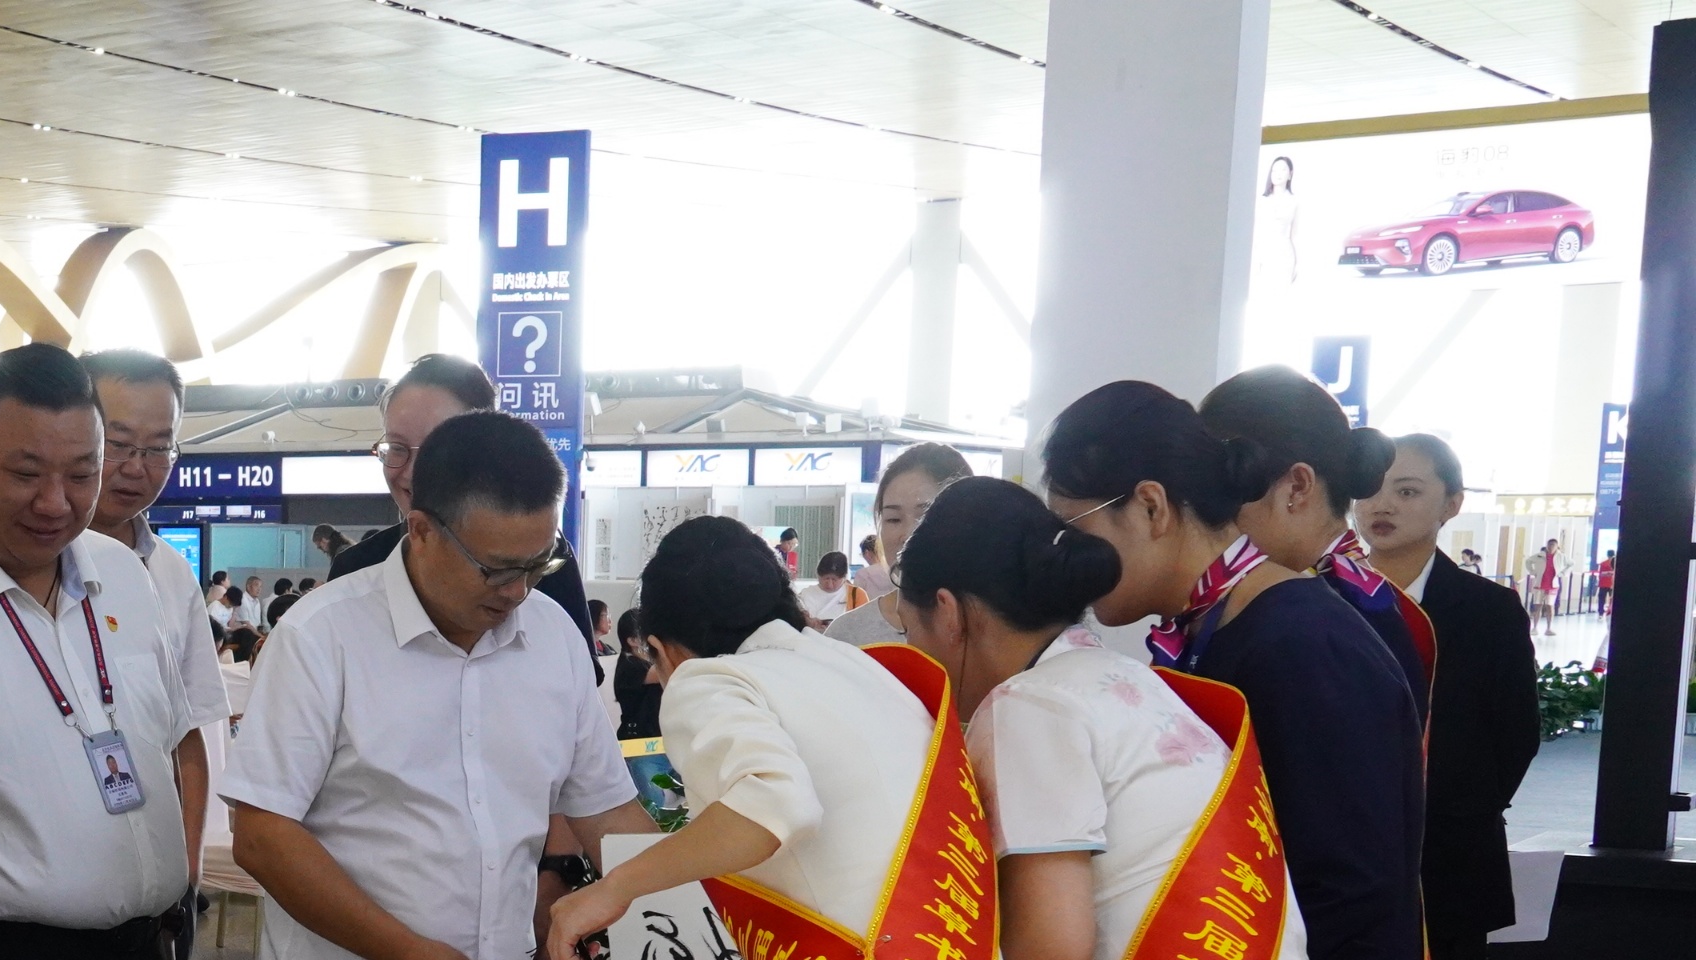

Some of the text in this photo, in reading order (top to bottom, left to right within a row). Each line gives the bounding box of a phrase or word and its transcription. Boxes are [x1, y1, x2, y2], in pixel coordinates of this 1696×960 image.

[498, 157, 570, 248] H
[492, 271, 570, 291] 国内出发办票区
[524, 291, 545, 302] Check
[553, 291, 570, 301] Area
[1327, 346, 1353, 394] J
[495, 382, 560, 409] 问讯
[180, 467, 212, 487] H11
[238, 465, 274, 487] H20
[182, 511, 194, 520] J17
[254, 510, 266, 519] J16
